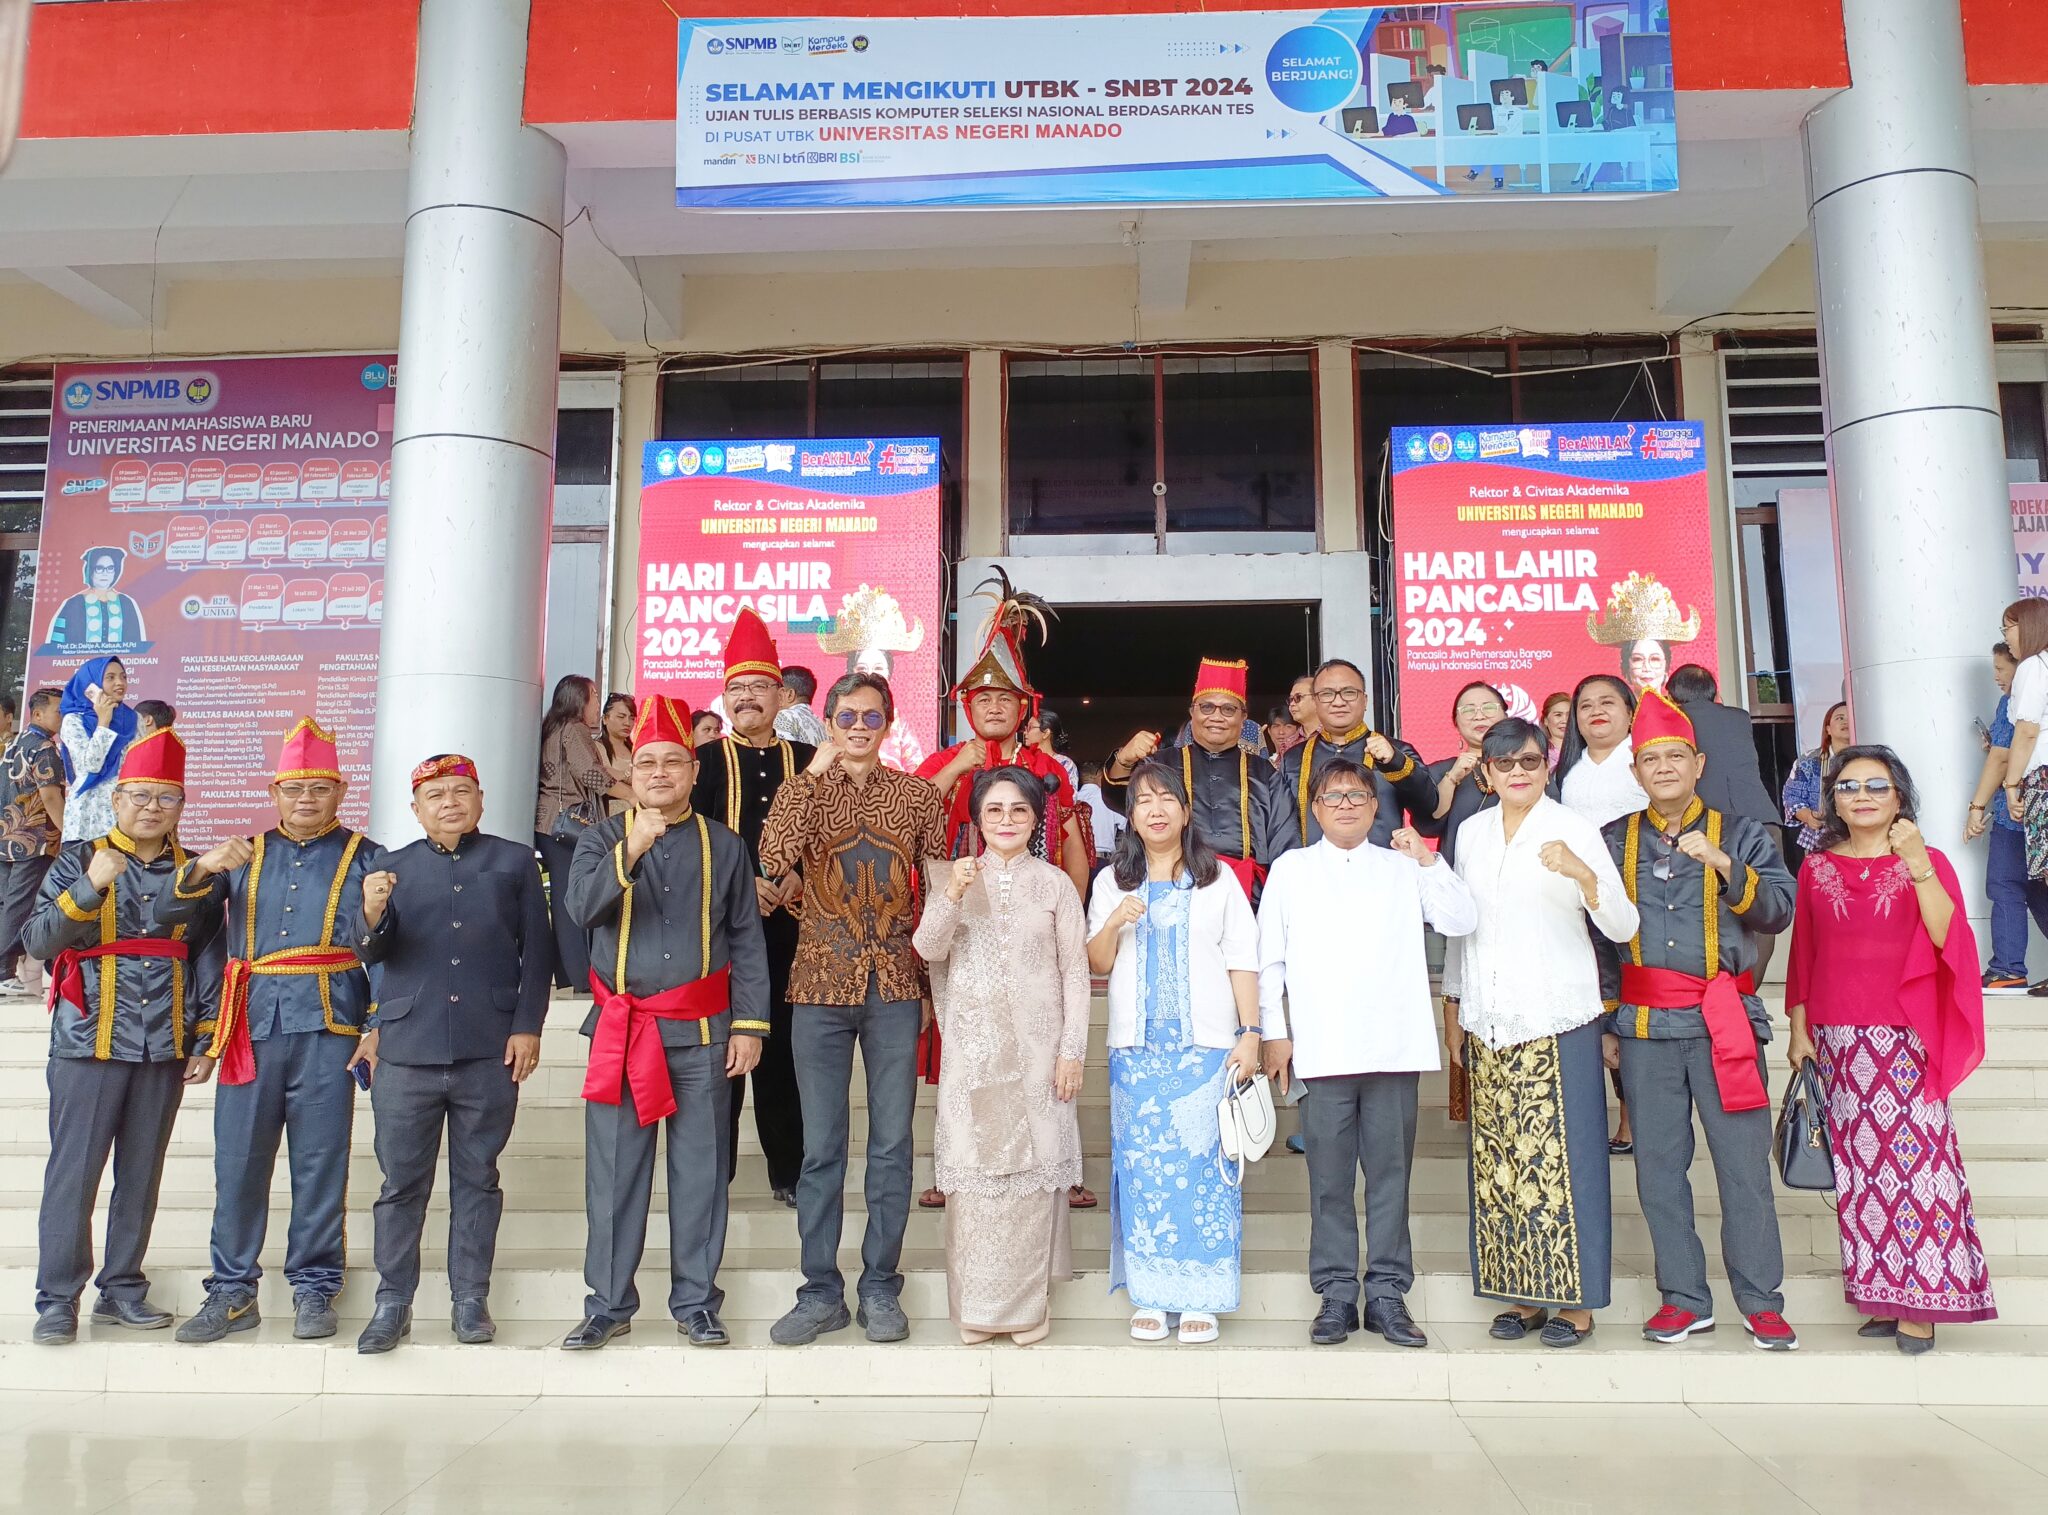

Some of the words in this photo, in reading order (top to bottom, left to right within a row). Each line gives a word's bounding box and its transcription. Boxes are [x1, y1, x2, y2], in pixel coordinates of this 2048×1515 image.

[726, 37, 777, 50] SNPMB
[808, 36, 845, 45] Kampus
[808, 43, 848, 52] Merdeka
[1282, 56, 1341, 67] SELAMAT
[1272, 69, 1353, 82] BERJUANG!
[706, 82, 835, 102] SELAMAT
[843, 80, 995, 100] MENGIKUTI
[1005, 80, 1079, 98] UTBK
[1105, 79, 1178, 98] SNBT
[1186, 77, 1253, 96] 2024
[706, 110, 749, 122] UJIAN
[754, 109, 794, 120] TULIS
[799, 108, 872, 120] BERBASIS
[876, 107, 959, 119] KOMPUTER
[963, 106, 1022, 118] SELEKSI
[1027, 105, 1104, 117] NASIONAL
[1108, 104, 1222, 116] BERDASARKAN
[1226, 103, 1254, 115] TES
[706, 132, 719, 142] DI
[724, 131, 772, 142] PUSAT
[776, 130, 814, 142] UTBK
[820, 126, 948, 142] UNIVERSITAS
[956, 124, 1028, 140] NEGERI
[1036, 123, 1122, 138] MANADO
[704, 157, 736, 166] mandiri
[758, 154, 780, 164] BNI
[819, 153, 837, 163] BRI
[840, 152, 860, 164] BSI
[364, 372, 384, 380] BLU
[96, 379, 180, 400] SNPMB
[69, 419, 168, 434] PENERIMAAN
[172, 416, 267, 432] MAHASISWA
[271, 414, 312, 428] BARU
[1658, 429, 1693, 438] bangga
[68, 435, 196, 456] UNIVERSITAS
[202, 434, 276, 452] NEGERI
[282, 431, 380, 449] MANADO
[1558, 437, 1631, 450] BerAKHLAK
[802, 452, 870, 466] BerAKHLAK
[1469, 486, 1509, 498] Rektor
[1512, 486, 1522, 497] &
[1526, 485, 1564, 496] Civitas
[1566, 484, 1630, 496] Akademika
[714, 500, 752, 511] Rektor
[756, 500, 764, 511] &
[768, 499, 804, 510] Civitas
[807, 498, 866, 510] Akademika
[1457, 506, 1536, 521] UNIVERSITAS
[1540, 504, 1584, 520] NEGERI
[1588, 503, 1644, 518] MANADO
[702, 518, 776, 534] UNIVERSITAS
[780, 518, 822, 533] NEGERI
[826, 516, 878, 532] MANADO
[2013, 516, 2048, 532] LAJA
[1502, 528, 1562, 538] mengucapkan
[1565, 526, 1600, 536] selamat
[742, 539, 800, 550] mengucapkan
[803, 538, 836, 548] selamat
[1404, 552, 1485, 580] HARI
[1496, 550, 1598, 578] LAHIR
[646, 562, 724, 592] HARI
[734, 562, 832, 590] LAHIR
[1405, 583, 1599, 613] PANCASILA
[203, 608, 236, 616] UNIMA
[646, 594, 830, 624] PANCASILA
[1404, 618, 1487, 646] 2024
[643, 628, 722, 656] 2024
[240, 654, 304, 662] KEOLAHRAGAAN
[336, 654, 374, 662] FAKULTAS
[1406, 650, 1447, 660] Pancasila
[1449, 650, 1470, 659] Jiwa
[1471, 648, 1518, 658] Pemersatu
[1520, 648, 1552, 660] Bangsa
[202, 664, 246, 672] KESEHATAN
[643, 659, 682, 668] Pancasila
[684, 658, 702, 668] Jiwa
[1408, 661, 1440, 672] Menuju
[1441, 660, 1482, 670] Indonesia
[1484, 660, 1508, 670] Emas
[1510, 659, 1532, 670] 2045
[643, 670, 674, 681] Menuju
[676, 669, 714, 679] Indonesia
[206, 684, 236, 692] Kepelatihan
[348, 692, 368, 700] Biologi
[316, 700, 336, 708] Biologi
[223, 710, 254, 718] BAHASA
[257, 710, 274, 718] DAN
[225, 738, 244, 746] Inggris
[352, 740, 368, 748] (M.Si)
[224, 746, 245, 754] Jepang
[230, 778, 246, 786] (S.Pd)
[352, 774, 370, 782] DAN
[242, 790, 270, 798] TEKNIK
